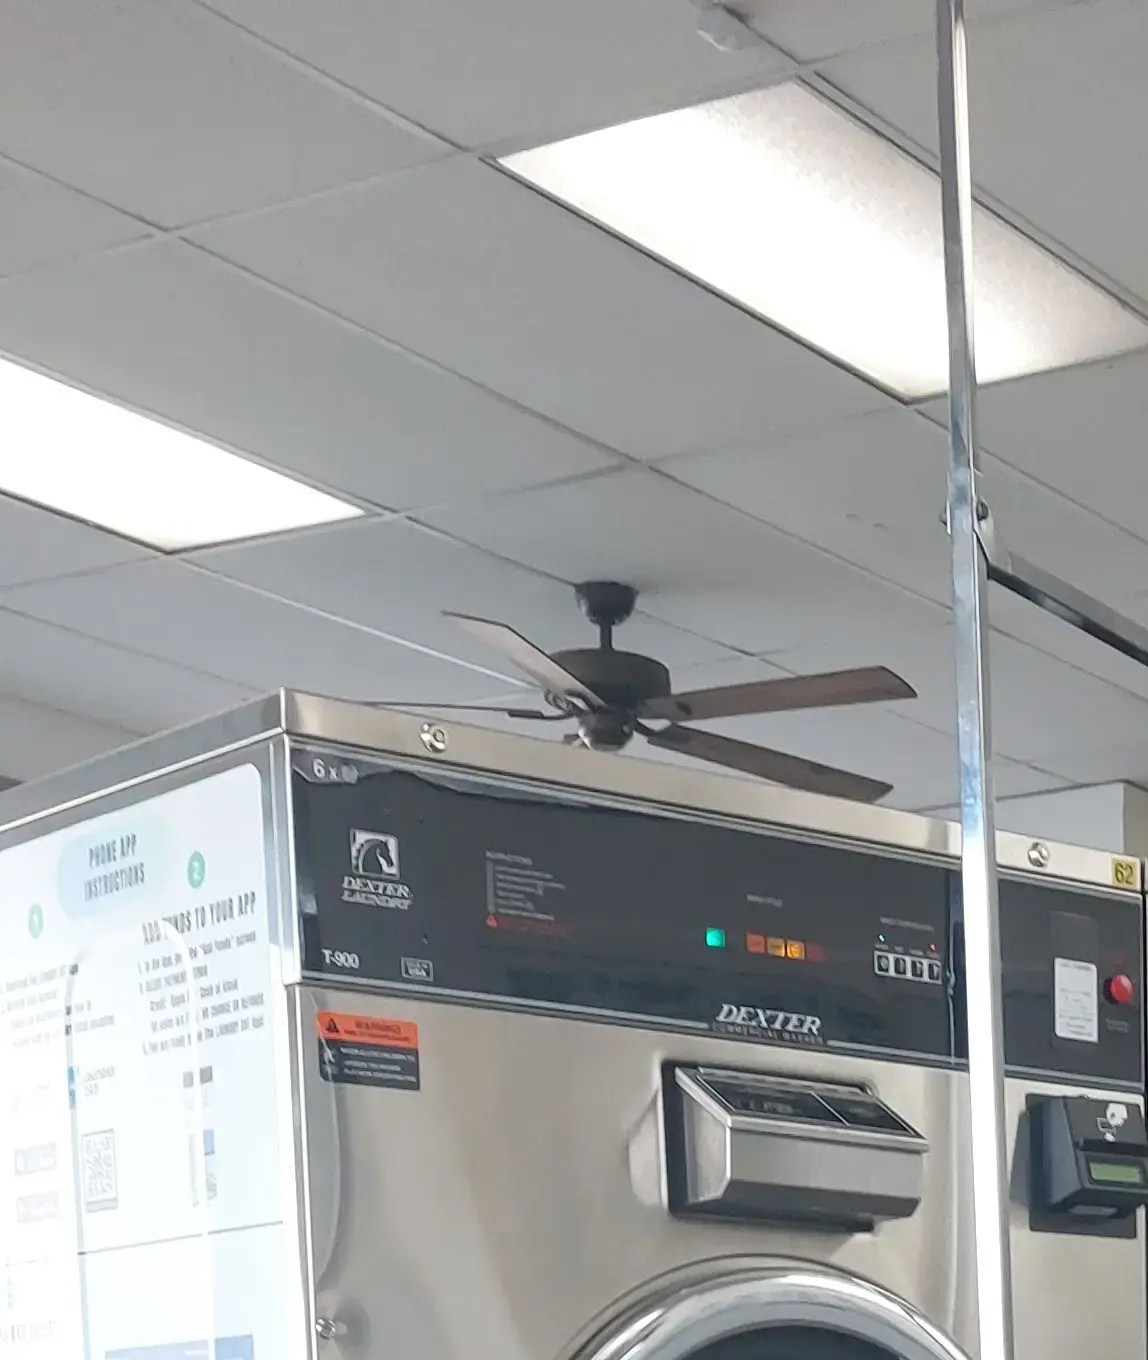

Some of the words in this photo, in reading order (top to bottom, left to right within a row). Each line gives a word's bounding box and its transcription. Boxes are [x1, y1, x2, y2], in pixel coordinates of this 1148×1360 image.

[89, 840, 116, 868] PHONE
[120, 833, 136, 858] APP
[84, 862, 144, 901] INSTRUCTIONS
[342, 875, 412, 898] DEXTER
[1114, 862, 1134, 885] 62
[195, 905, 206, 930] TO
[209, 897, 234, 926] YOUR
[238, 891, 256, 917] APP
[322, 948, 360, 969] T-900
[716, 1003, 822, 1036] DEXTER
